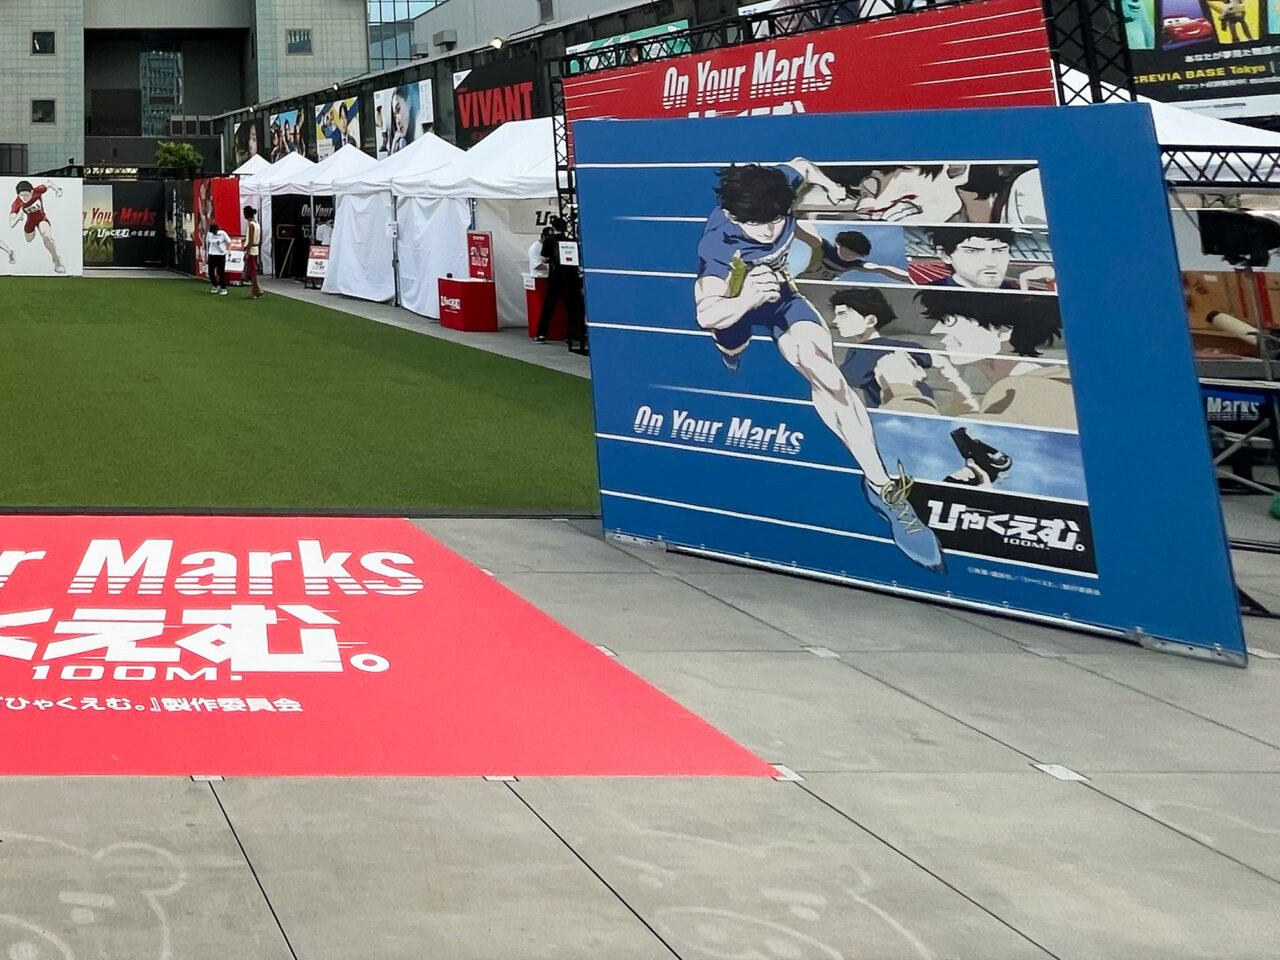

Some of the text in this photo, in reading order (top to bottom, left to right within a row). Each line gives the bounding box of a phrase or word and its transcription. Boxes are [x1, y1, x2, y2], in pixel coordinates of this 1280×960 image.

[662, 43, 835, 109] On Your Marks
[1185, 67, 1226, 79] BASE
[458, 81, 533, 128] VIVANT
[633, 405, 804, 455] On Your Marks
[1206, 396, 1260, 421] Marks
[67, 538, 424, 596] Marks
